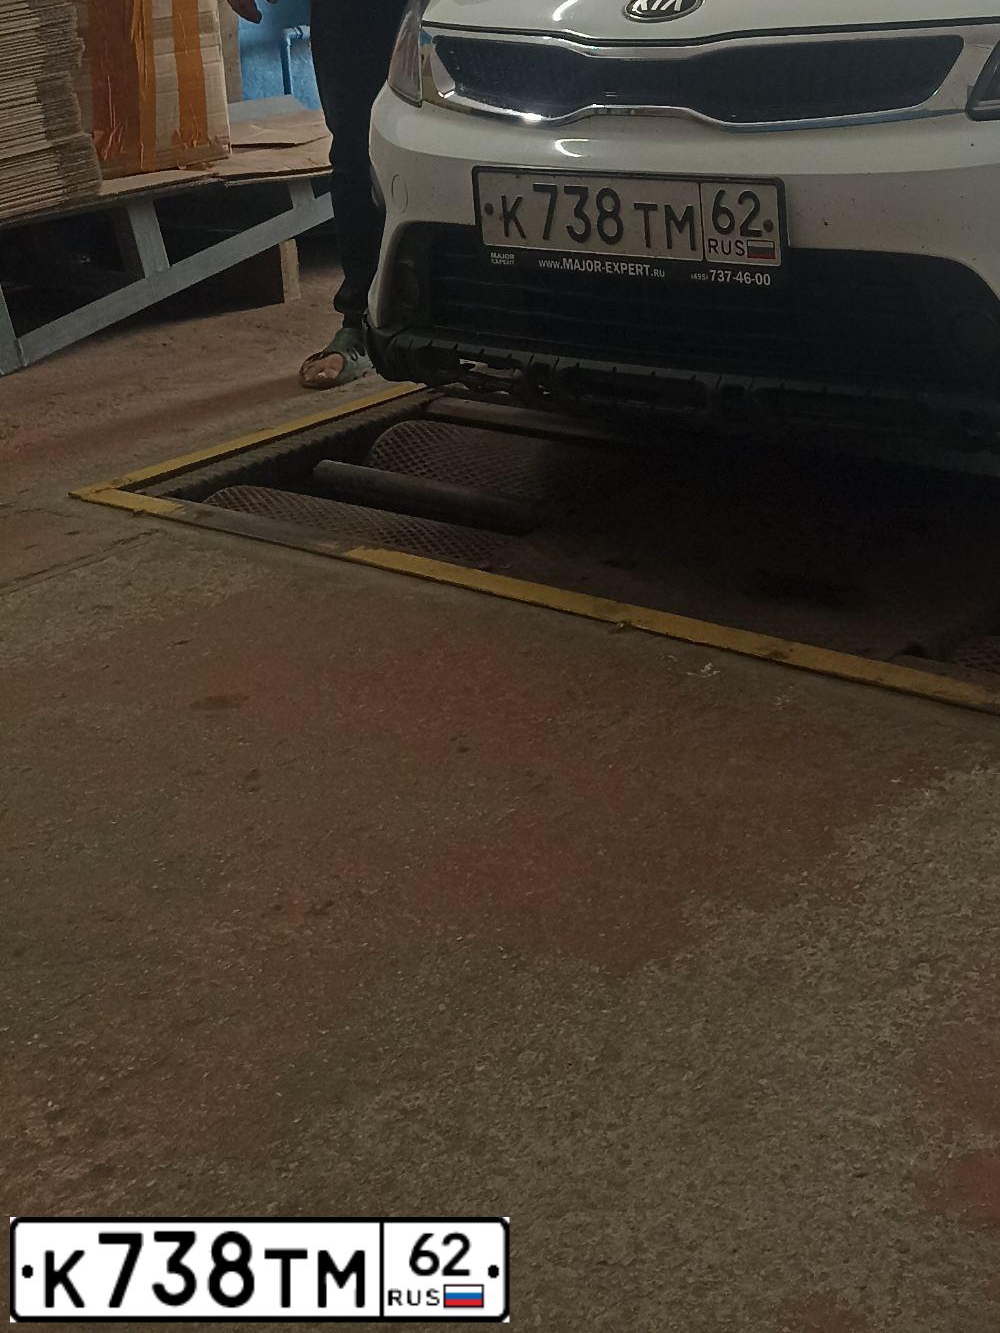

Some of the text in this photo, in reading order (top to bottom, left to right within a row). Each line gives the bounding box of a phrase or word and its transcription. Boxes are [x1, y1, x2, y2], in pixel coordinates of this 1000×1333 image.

[711, 188, 763, 238] 62
[707, 237, 746, 257] RUS
[709, 269, 771, 286] 737-46-00
